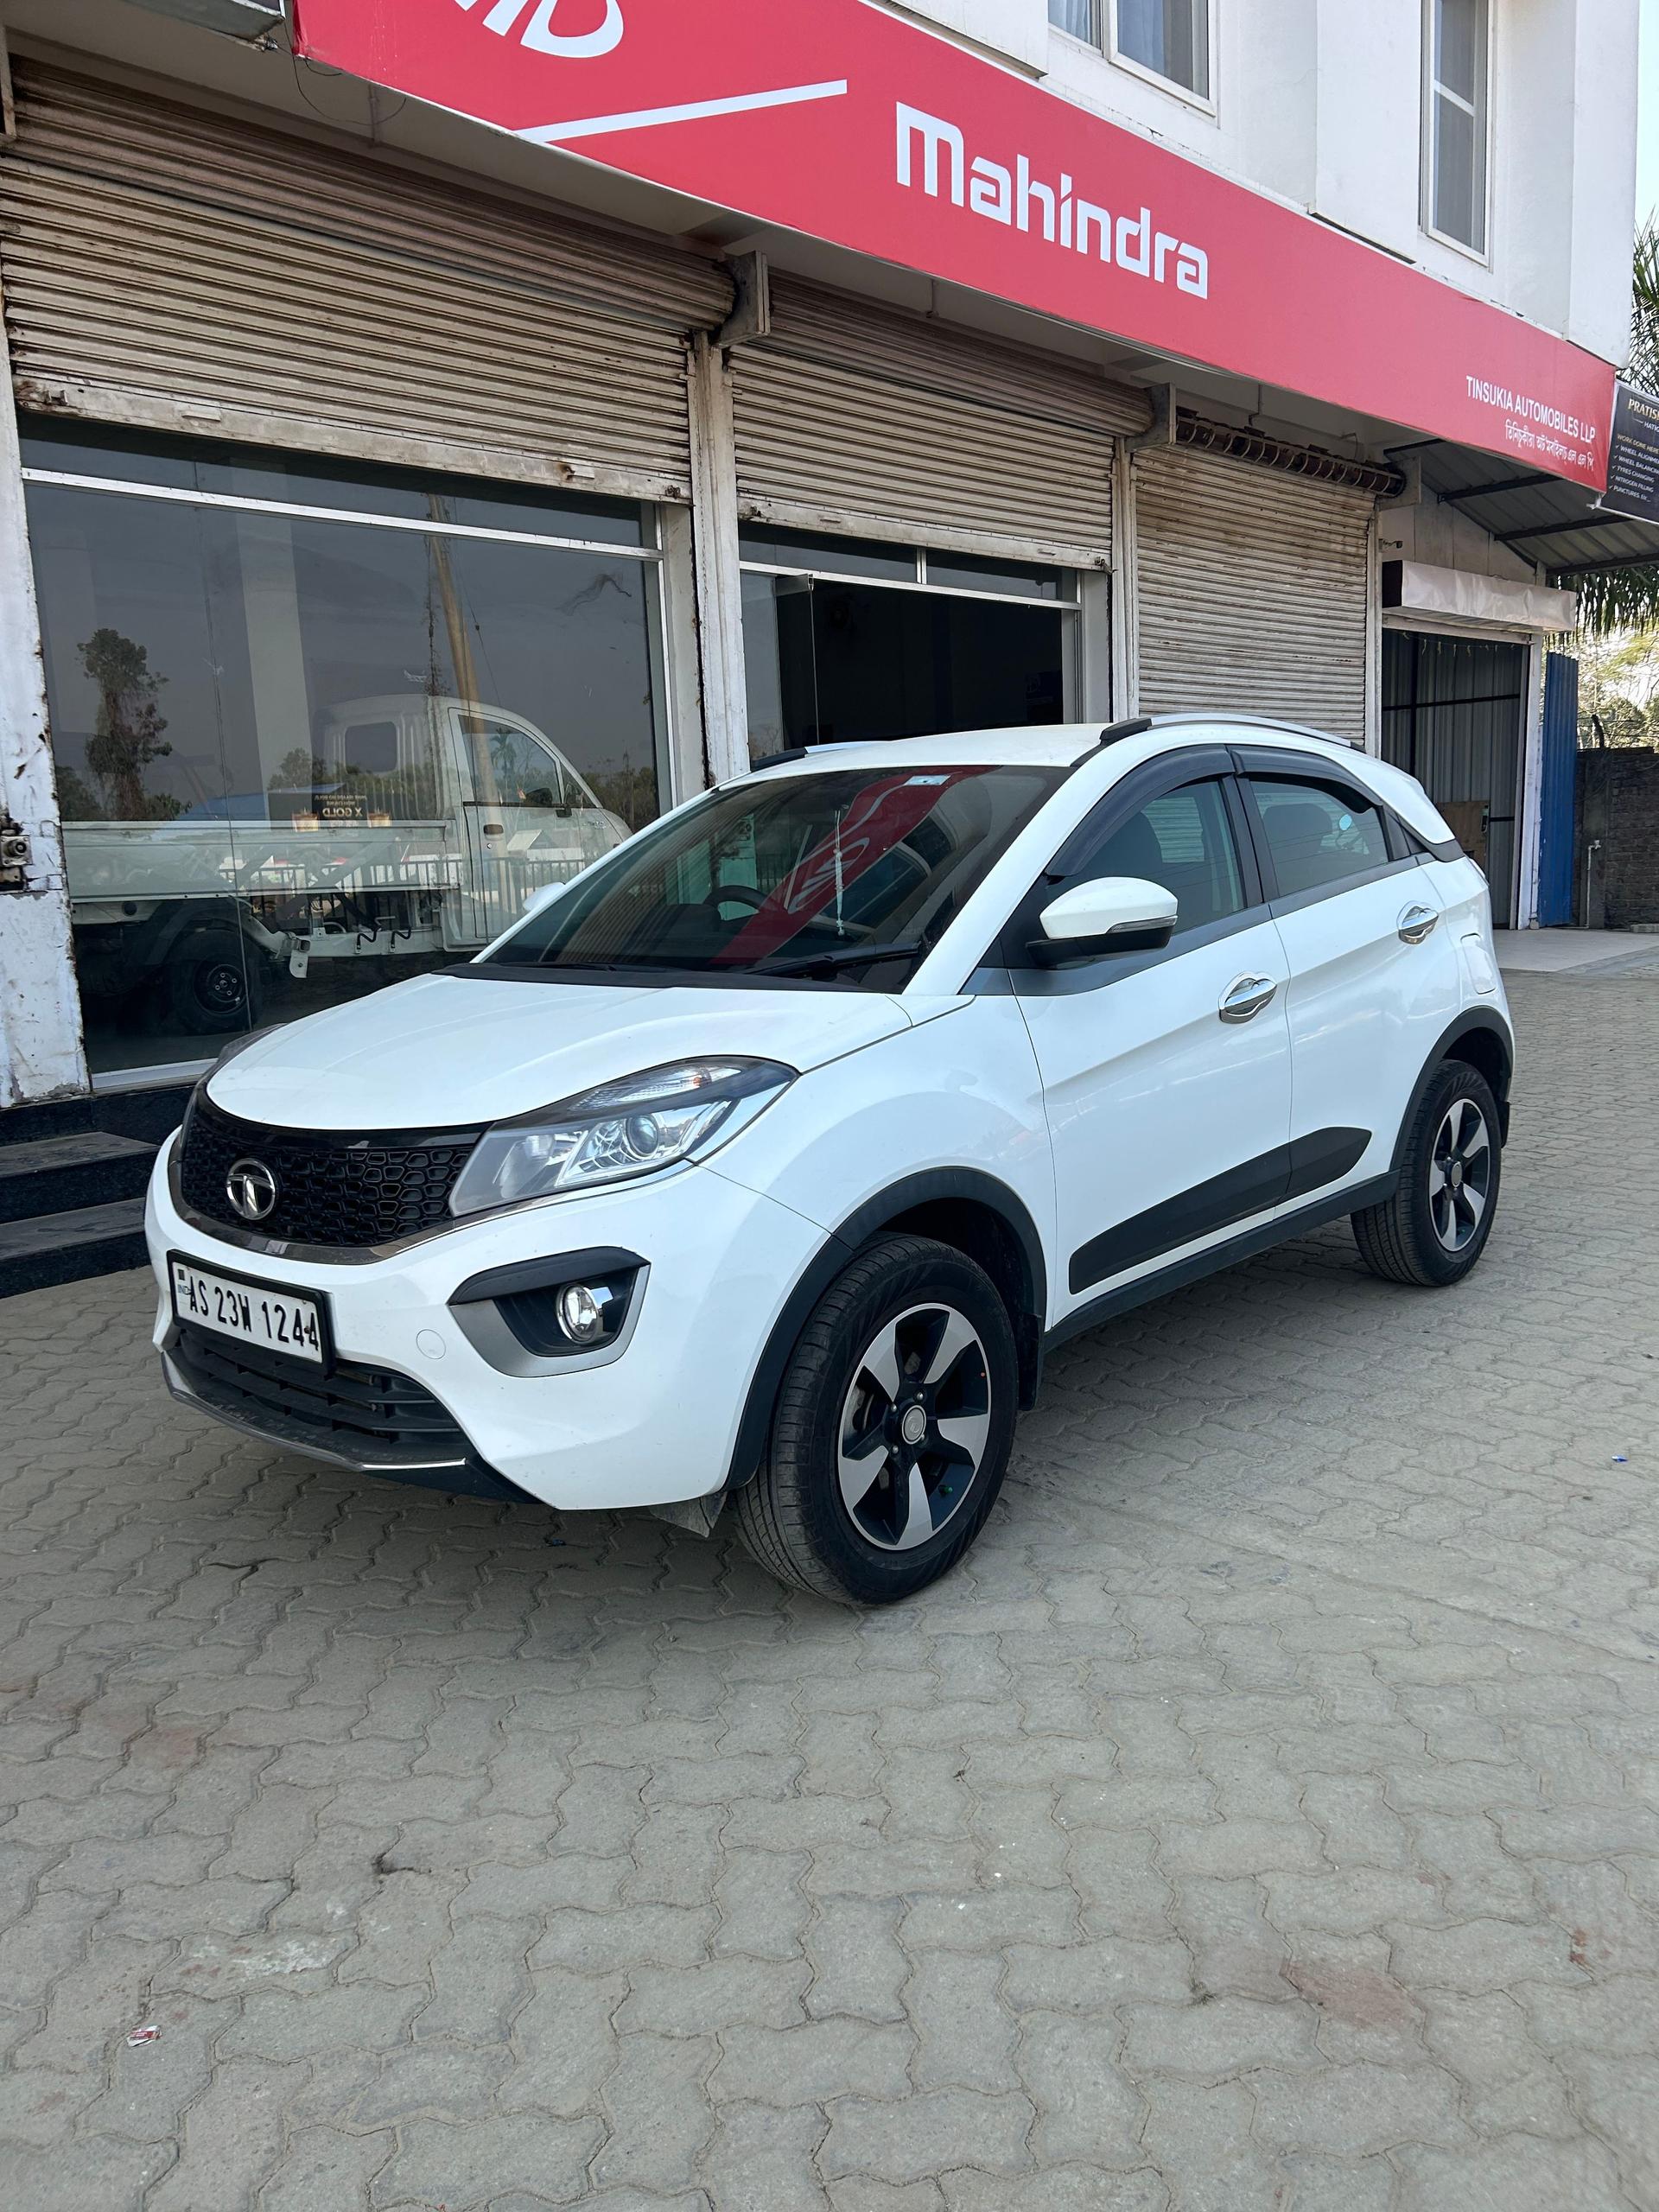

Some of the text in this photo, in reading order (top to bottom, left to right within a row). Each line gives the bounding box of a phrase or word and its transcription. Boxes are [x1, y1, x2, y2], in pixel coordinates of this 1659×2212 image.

[896, 101, 1208, 300] Mahindra
[1465, 375, 1596, 443] TINSUKIA AUTOMOBILES LLP
[1628, 398, 1659, 421] PRATIS
[1620, 445, 1637, 456] WHEEL
[1618, 455, 1635, 467] WHEEL
[1617, 465, 1631, 475] TYRES
[1615, 475, 1638, 487] NITROGEN
[190, 1275, 319, 1351] AS 23W 1244
